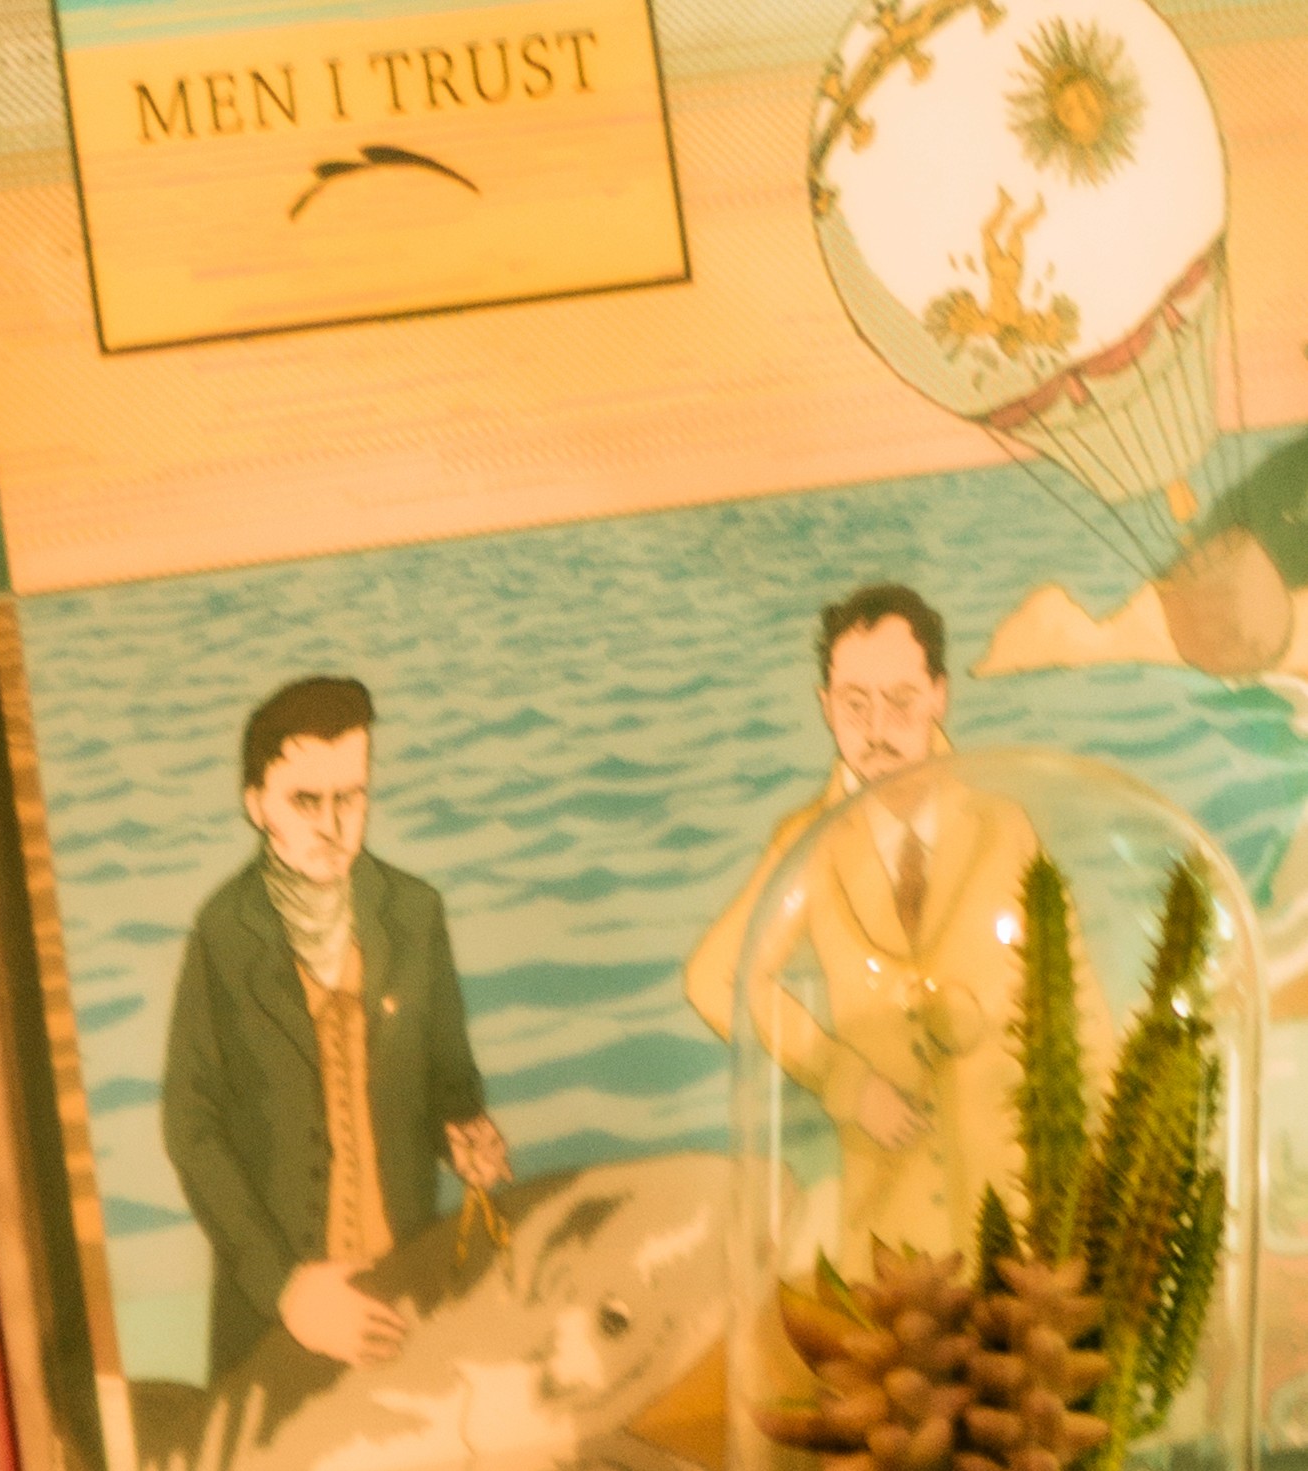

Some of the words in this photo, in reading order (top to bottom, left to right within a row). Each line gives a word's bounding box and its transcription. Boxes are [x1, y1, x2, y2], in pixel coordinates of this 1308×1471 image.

[132, 62, 300, 144] MEN
[323, 56, 352, 122] I
[369, 28, 598, 116] TRUST
